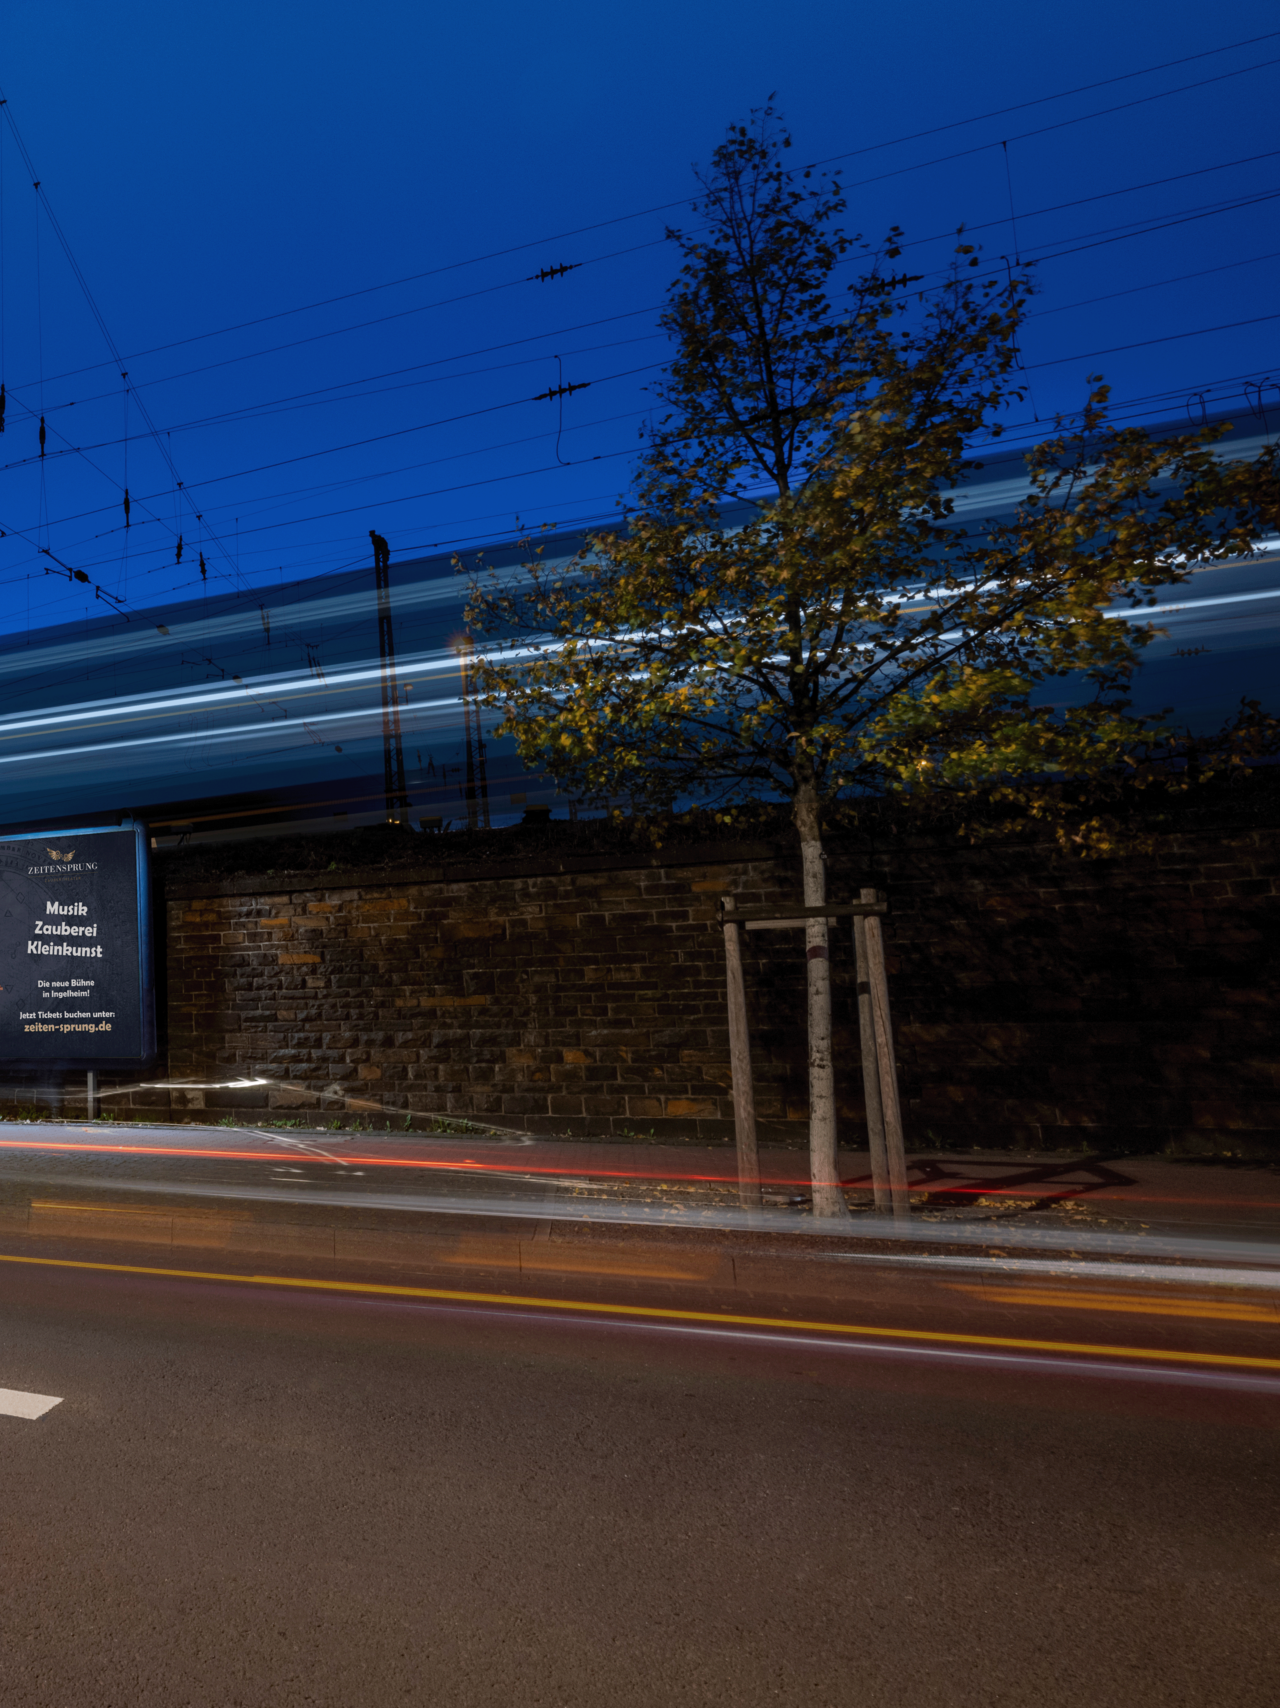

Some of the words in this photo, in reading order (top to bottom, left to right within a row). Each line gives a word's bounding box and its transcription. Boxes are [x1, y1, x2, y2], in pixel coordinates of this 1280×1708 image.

[27, 862, 98, 875] ZEITENSPRUNG
[46, 901, 88, 916] Musik
[34, 921, 97, 937] Zauberei
[27, 941, 103, 958] Kleinkunst
[37, 980, 50, 988] Die
[71, 979, 95, 987] Bühne
[51, 989, 90, 998] Ingelheim!
[19, 1011, 36, 1020] Jetzt
[38, 1011, 62, 1019] Tickets
[24, 1021, 112, 1034] zeiten-sprung.de
